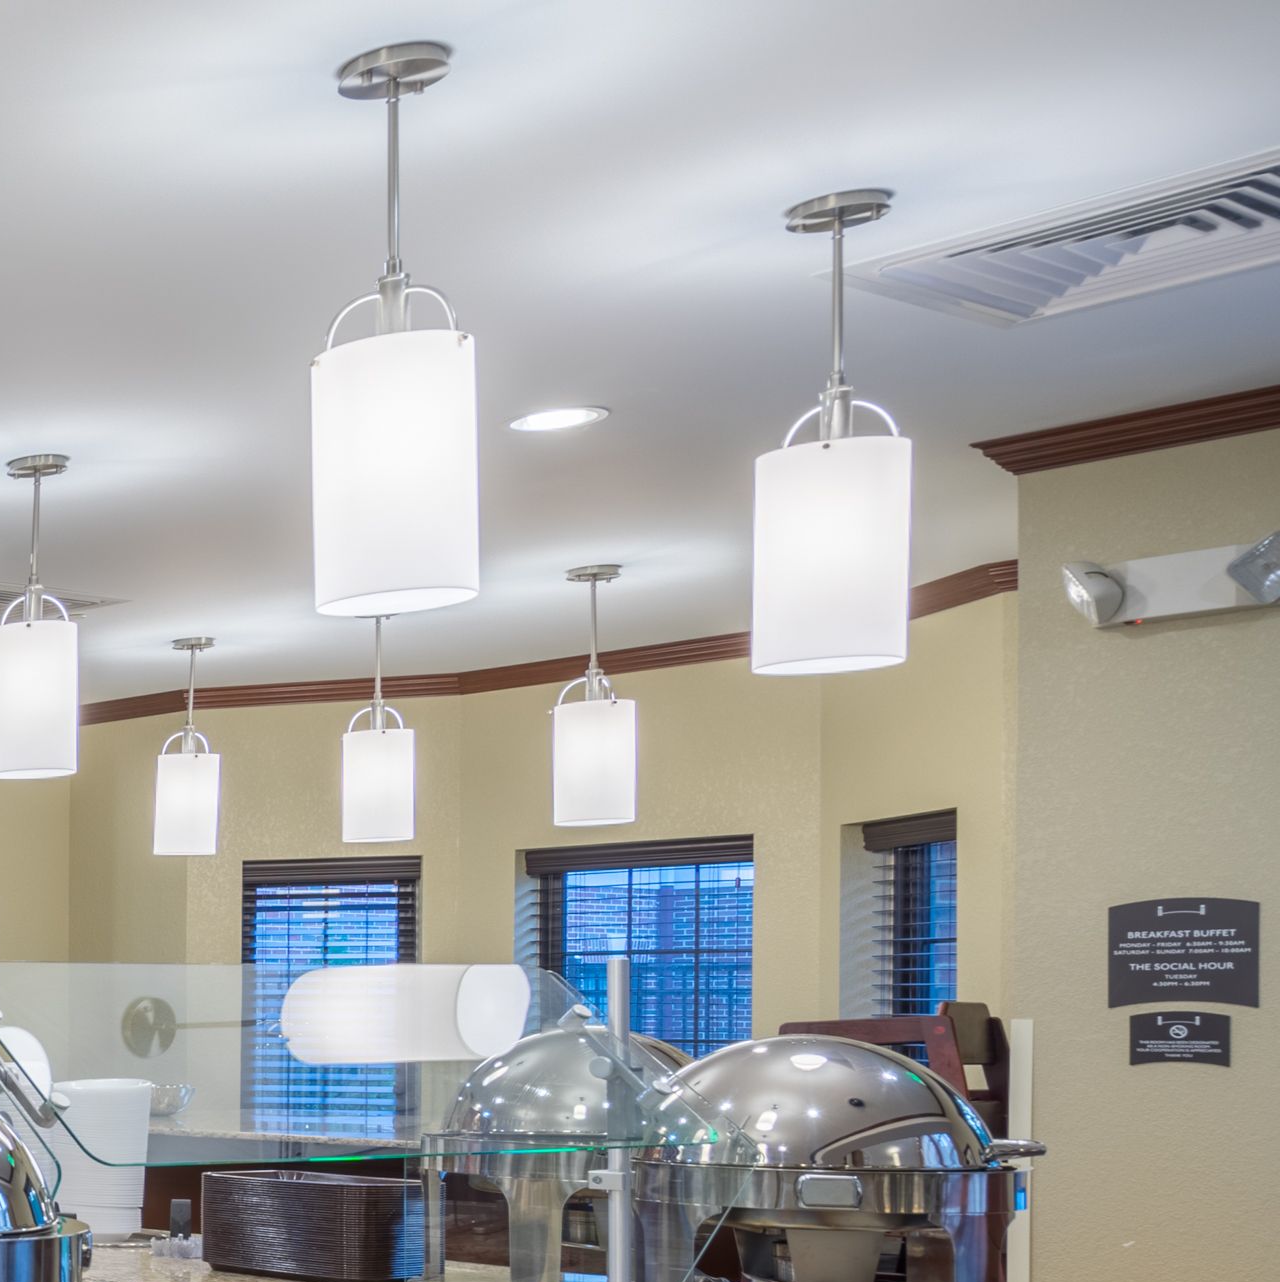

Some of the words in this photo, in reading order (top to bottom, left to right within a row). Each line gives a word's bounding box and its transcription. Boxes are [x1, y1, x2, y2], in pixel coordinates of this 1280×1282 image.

[1127, 929, 1191, 940] BREAKFAST
[1193, 928, 1237, 938] BUFFET
[1129, 962, 1152, 971] THE
[1153, 962, 1197, 971] SOCIAL
[1198, 961, 1235, 970] HOUR
